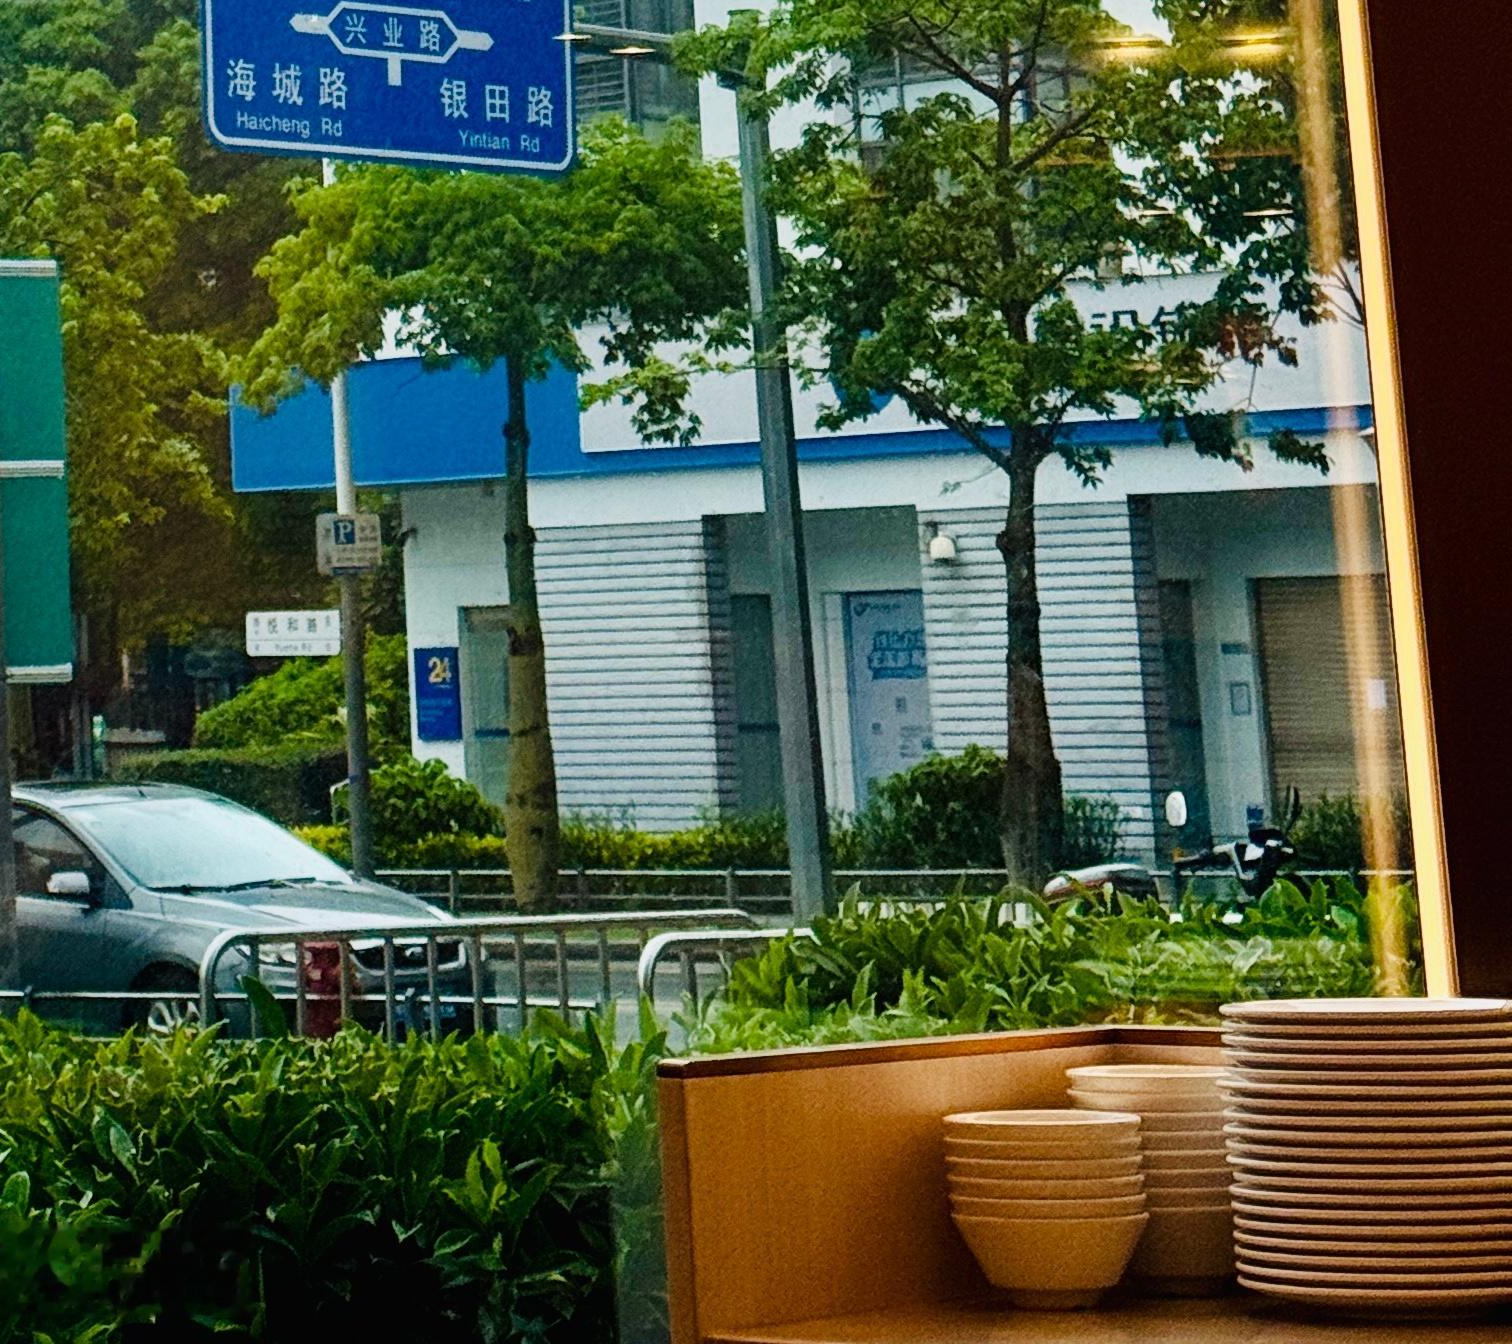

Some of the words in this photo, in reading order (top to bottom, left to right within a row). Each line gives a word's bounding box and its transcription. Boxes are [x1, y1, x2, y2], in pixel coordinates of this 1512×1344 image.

[344, 14, 441, 53] 兴业路
[227, 59, 349, 111] 海城路
[440, 78, 555, 129] 银田路
[236, 111, 311, 139] Haicheng
[321, 118, 343, 138] Rd
[459, 129, 510, 151] Yintian
[520, 135, 541, 153] Rd
[337, 521, 352, 544] P
[428, 656, 452, 684] 24
